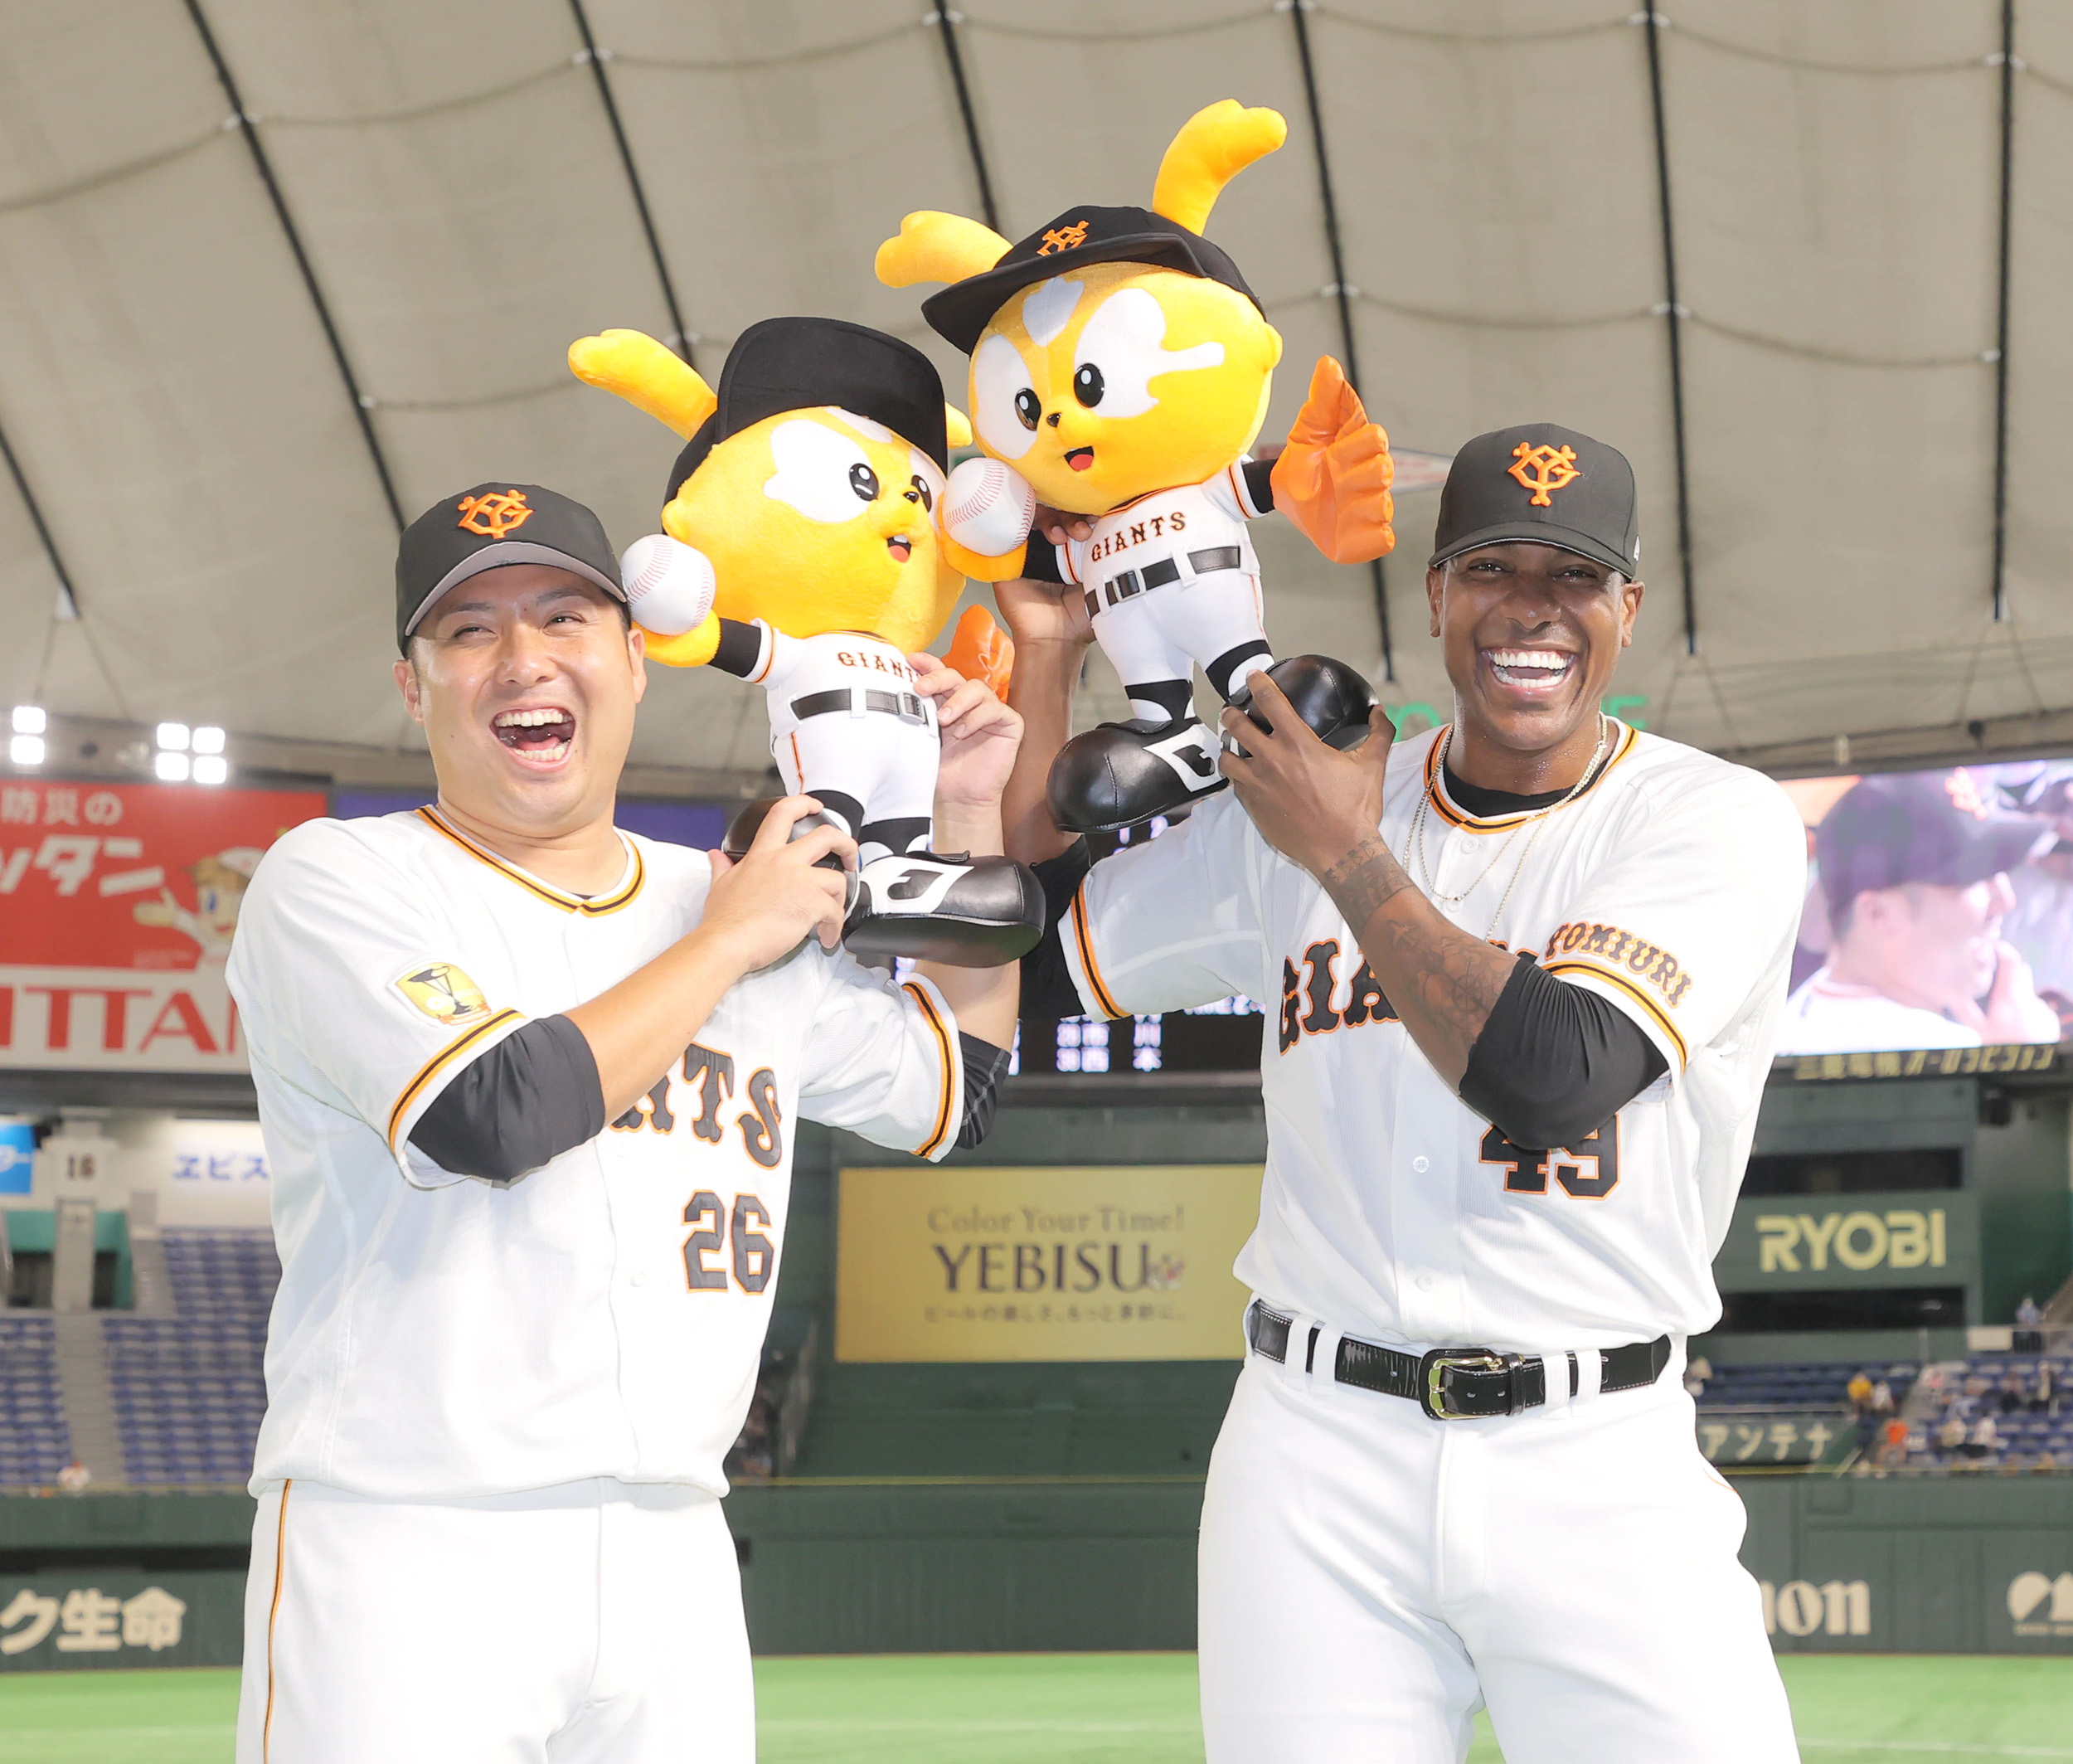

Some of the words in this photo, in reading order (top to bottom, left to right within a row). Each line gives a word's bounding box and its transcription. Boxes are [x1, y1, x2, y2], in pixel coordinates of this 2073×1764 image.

[1090, 511, 1187, 562] GIANTS
[836, 651, 919, 683] GIANT
[1545, 921, 1693, 1009] YOMIURI
[1478, 1111, 1621, 1201] 49
[680, 1188, 775, 1296] 26
[926, 1205, 1013, 1234] Color
[1021, 1205, 1090, 1233] Your
[1755, 1208, 1947, 1273] RYOBI
[931, 1242, 1151, 1294] YEBISU
[1701, 1422, 1833, 1461] アンテナ
[0, 1586, 187, 1655] ク生命
